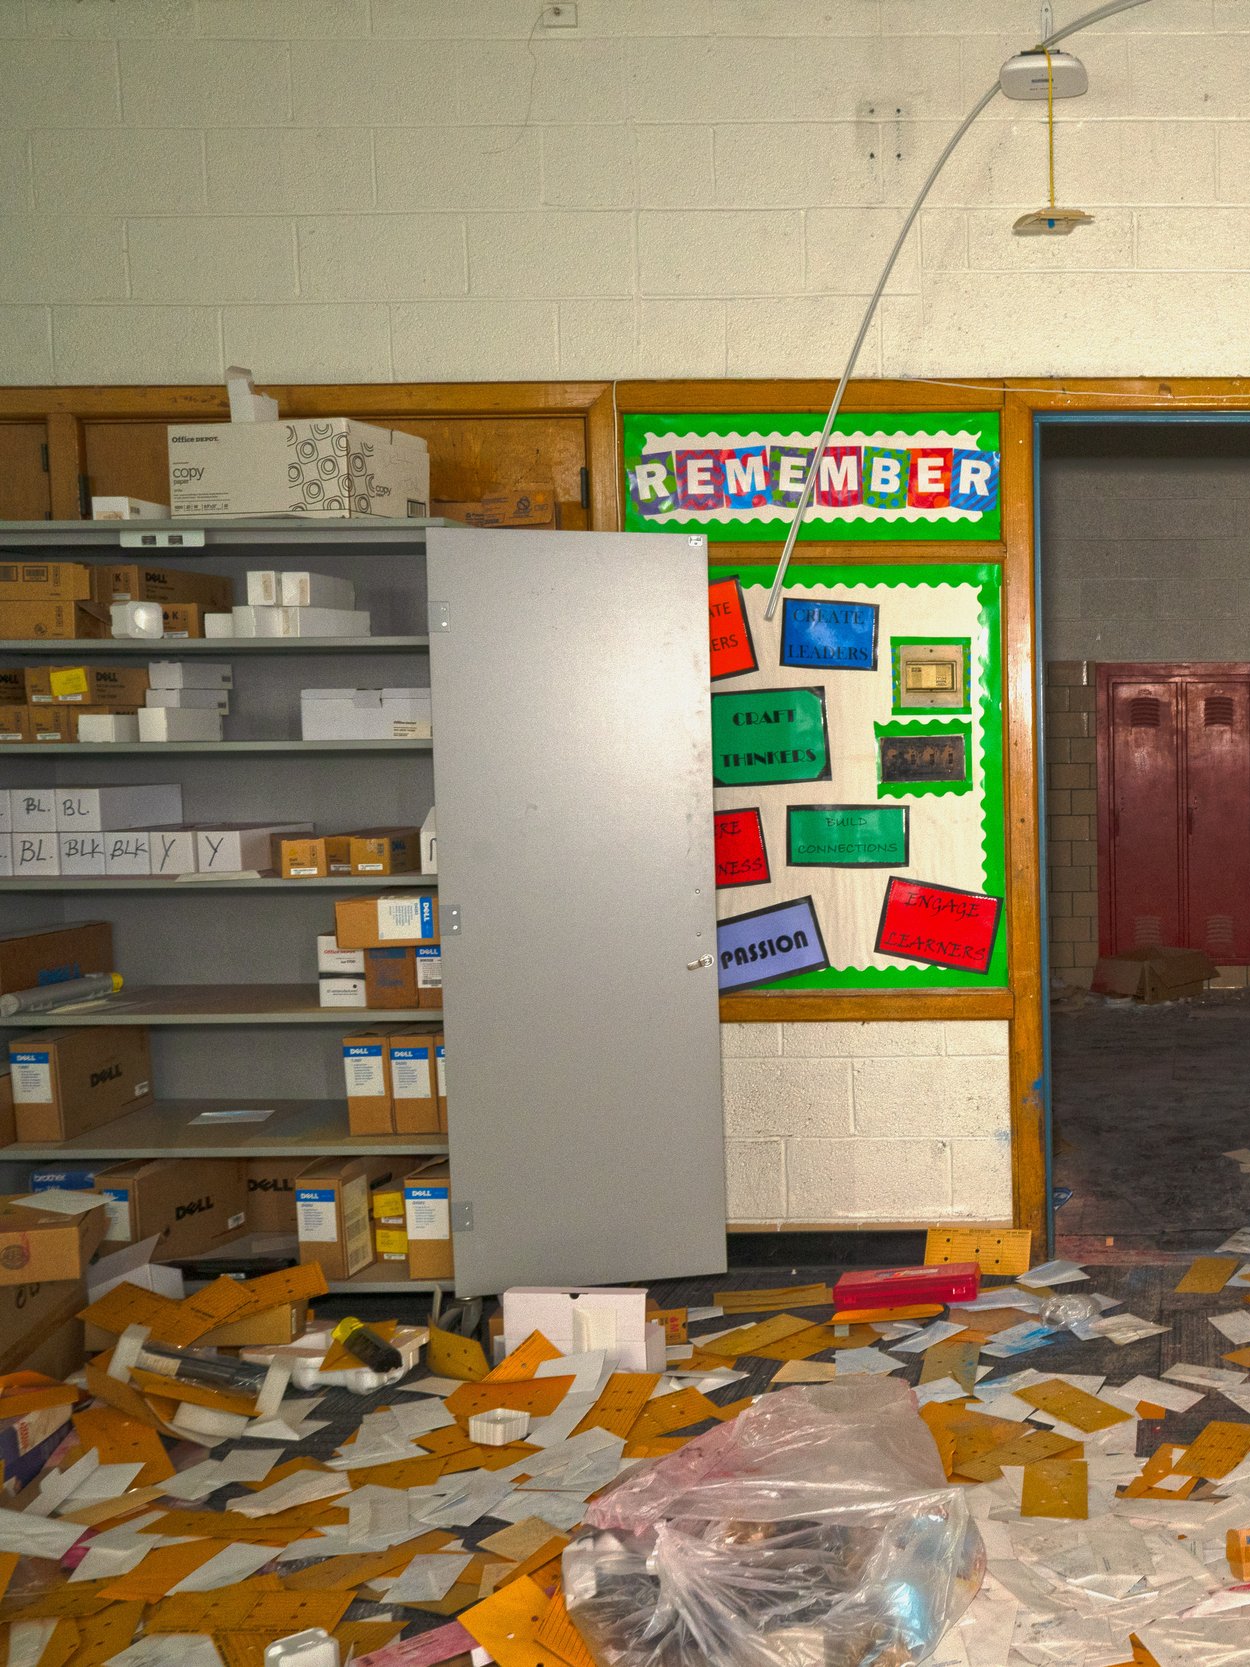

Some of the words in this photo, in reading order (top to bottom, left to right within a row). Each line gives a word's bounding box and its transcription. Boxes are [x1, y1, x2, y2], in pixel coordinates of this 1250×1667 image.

[172, 465, 205, 480] copy
[635, 455, 991, 500] REMEMBER
[793, 608, 865, 625] CREATE
[788, 644, 869, 661] LEADERS
[732, 709, 796, 726] CRAFT
[720, 748, 817, 767] THINKERS
[826, 817, 868, 828] BUILD
[205, 836, 224, 867] Y
[797, 843, 898, 855] CONNECTIONS
[903, 892, 980, 921] ENGAGE
[720, 930, 809, 970] PASSION
[883, 931, 988, 961] LEARNERS
[90, 1064, 124, 1088] DELL
[34, 1174, 65, 1182] brother
[247, 1179, 293, 1192] DELL
[300, 1192, 318, 1200] DELL
[175, 1196, 214, 1221] DELL
